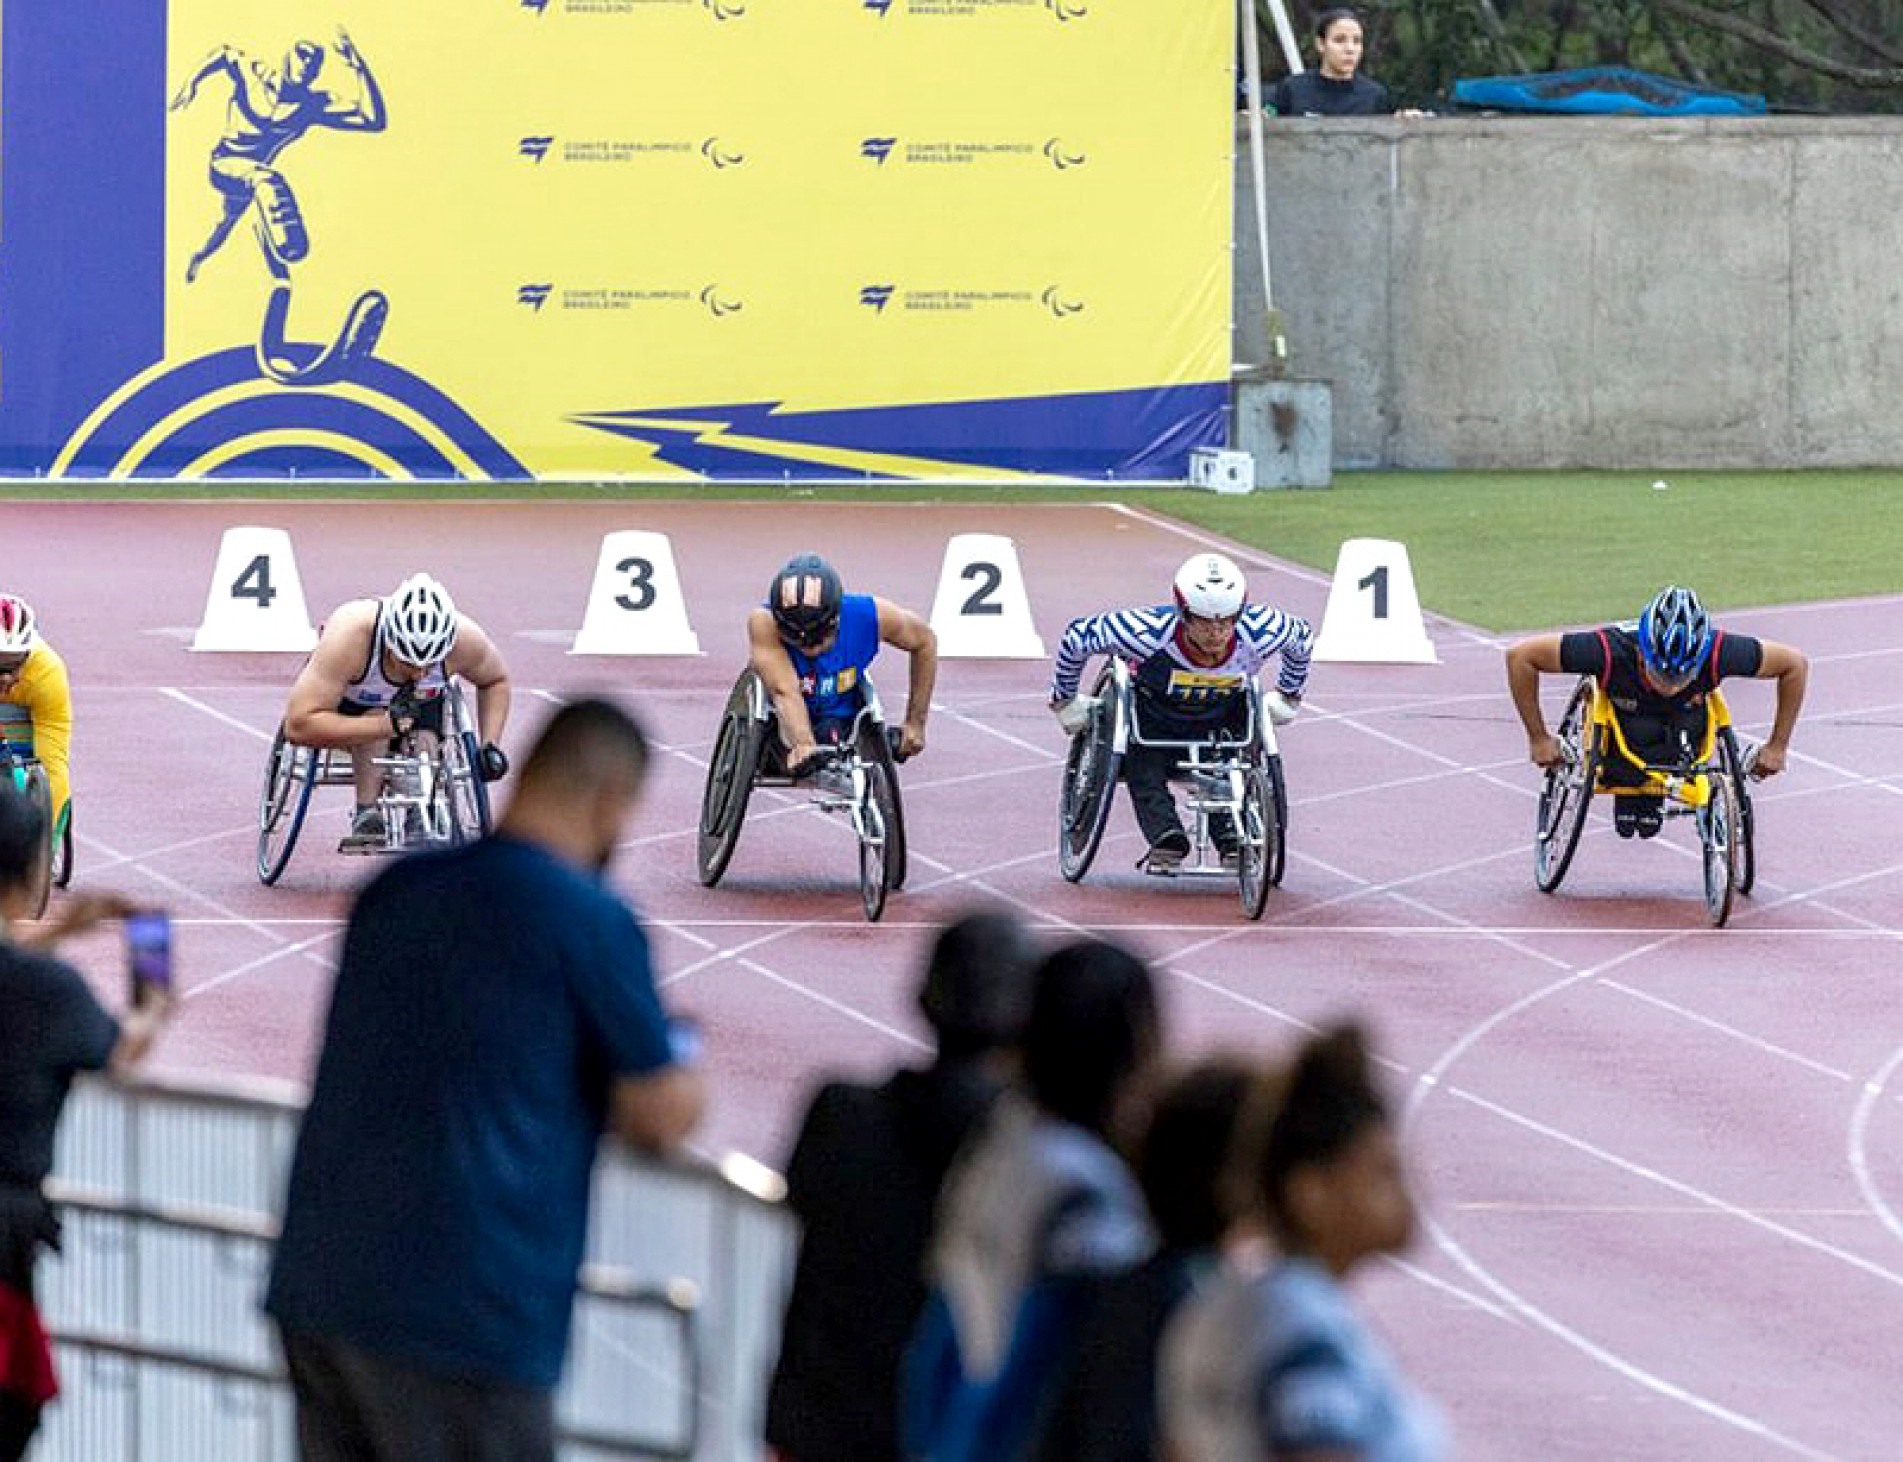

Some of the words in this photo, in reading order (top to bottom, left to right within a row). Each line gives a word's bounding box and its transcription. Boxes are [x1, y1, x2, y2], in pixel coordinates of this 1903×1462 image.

[231, 555, 276, 607] 4
[616, 557, 656, 611] 3
[961, 562, 1002, 615] 2
[1359, 566, 1388, 618] 1
